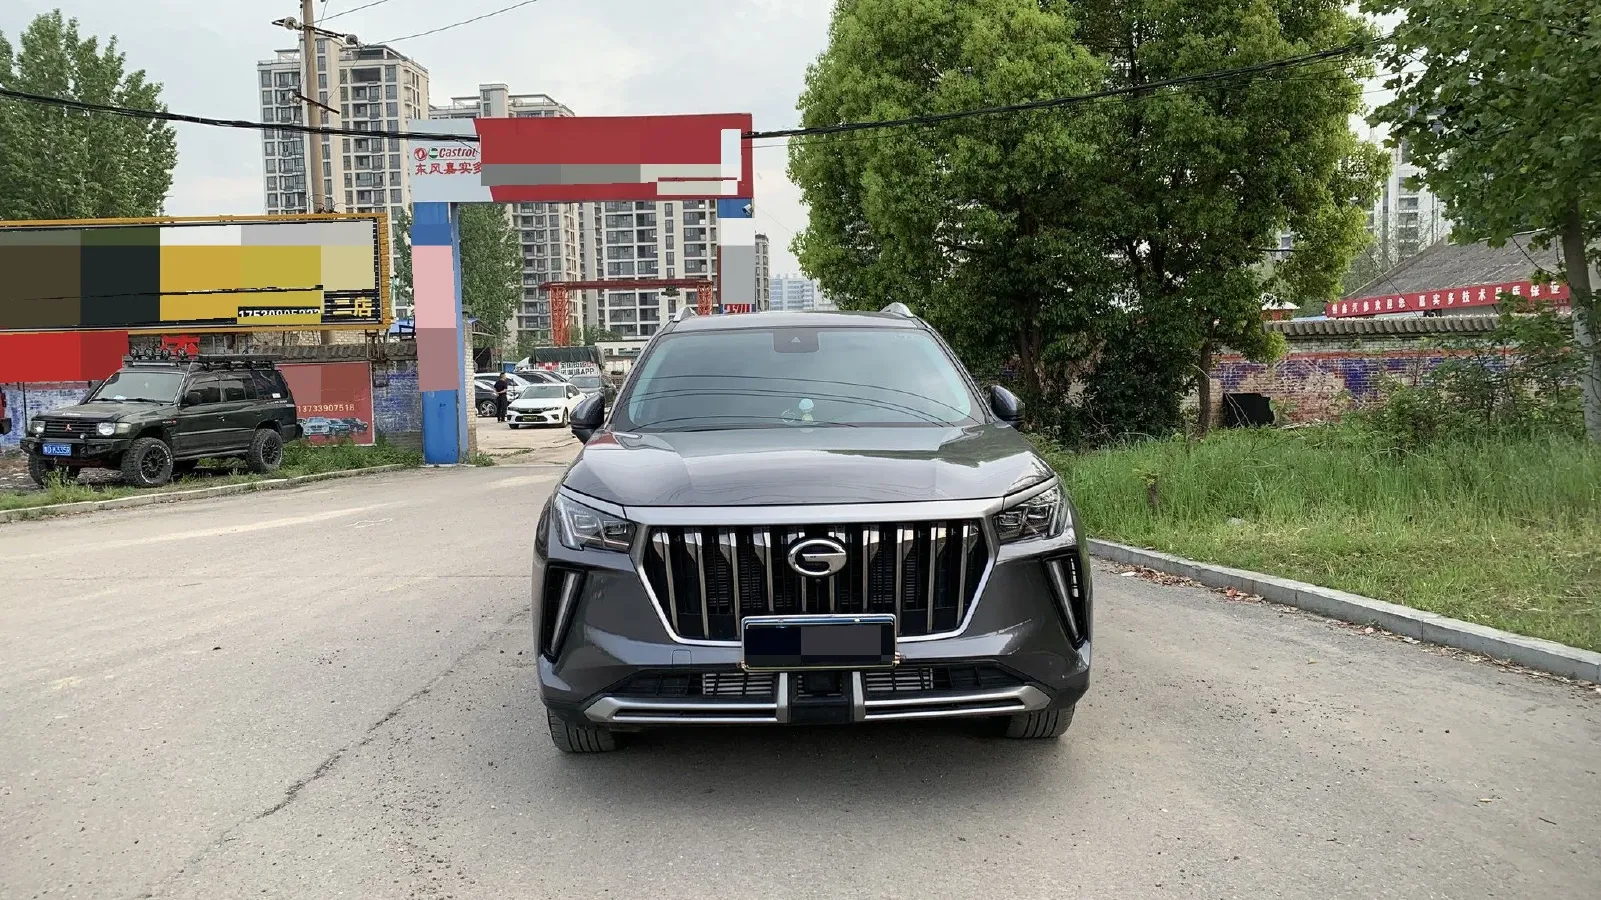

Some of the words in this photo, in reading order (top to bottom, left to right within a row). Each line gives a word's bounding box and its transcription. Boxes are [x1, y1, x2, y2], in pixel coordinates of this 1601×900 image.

[439, 147, 476, 158] Castrol
[415, 161, 481, 175] 东风嘉实多
[297, 404, 355, 413] 13733907518
